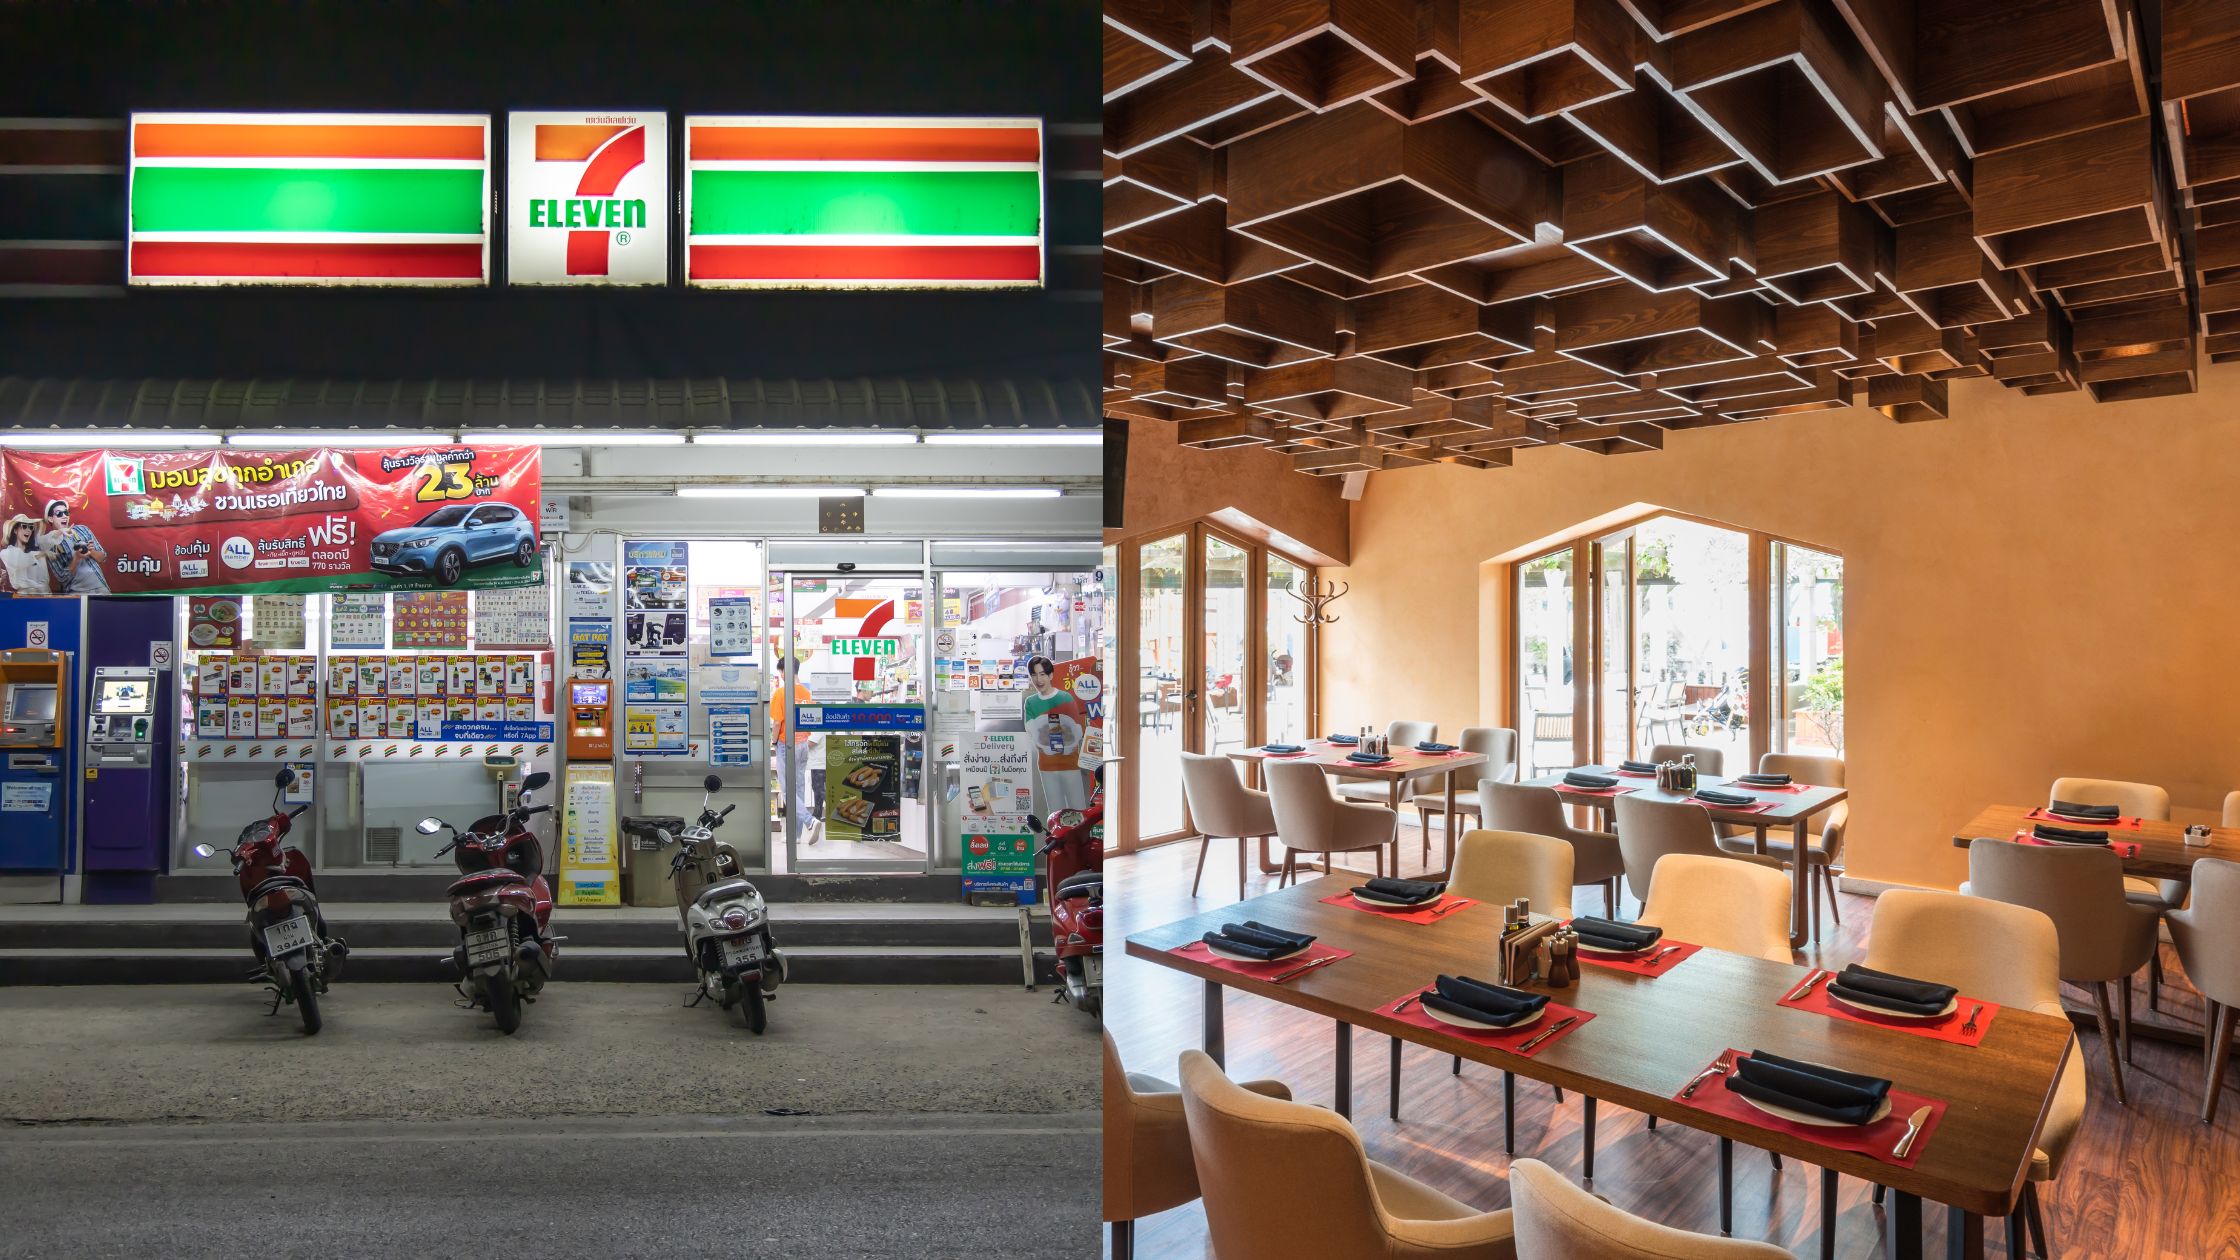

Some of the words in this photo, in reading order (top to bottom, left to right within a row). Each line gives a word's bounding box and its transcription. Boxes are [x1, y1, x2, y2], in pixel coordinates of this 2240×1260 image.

[535, 124, 645, 275] 7
[416, 462, 474, 501] 23
[215, 480, 347, 510] ชวนเธอเที่ยวไทย
[308, 515, 356, 547] ฟรี!
[224, 544, 250, 555] ALL
[312, 548, 350, 560] ตลอดปี
[1077, 680, 1098, 689] ALL
[980, 742, 1015, 751] Delivery
[277, 936, 306, 952] 3944
[735, 953, 757, 963] 355
